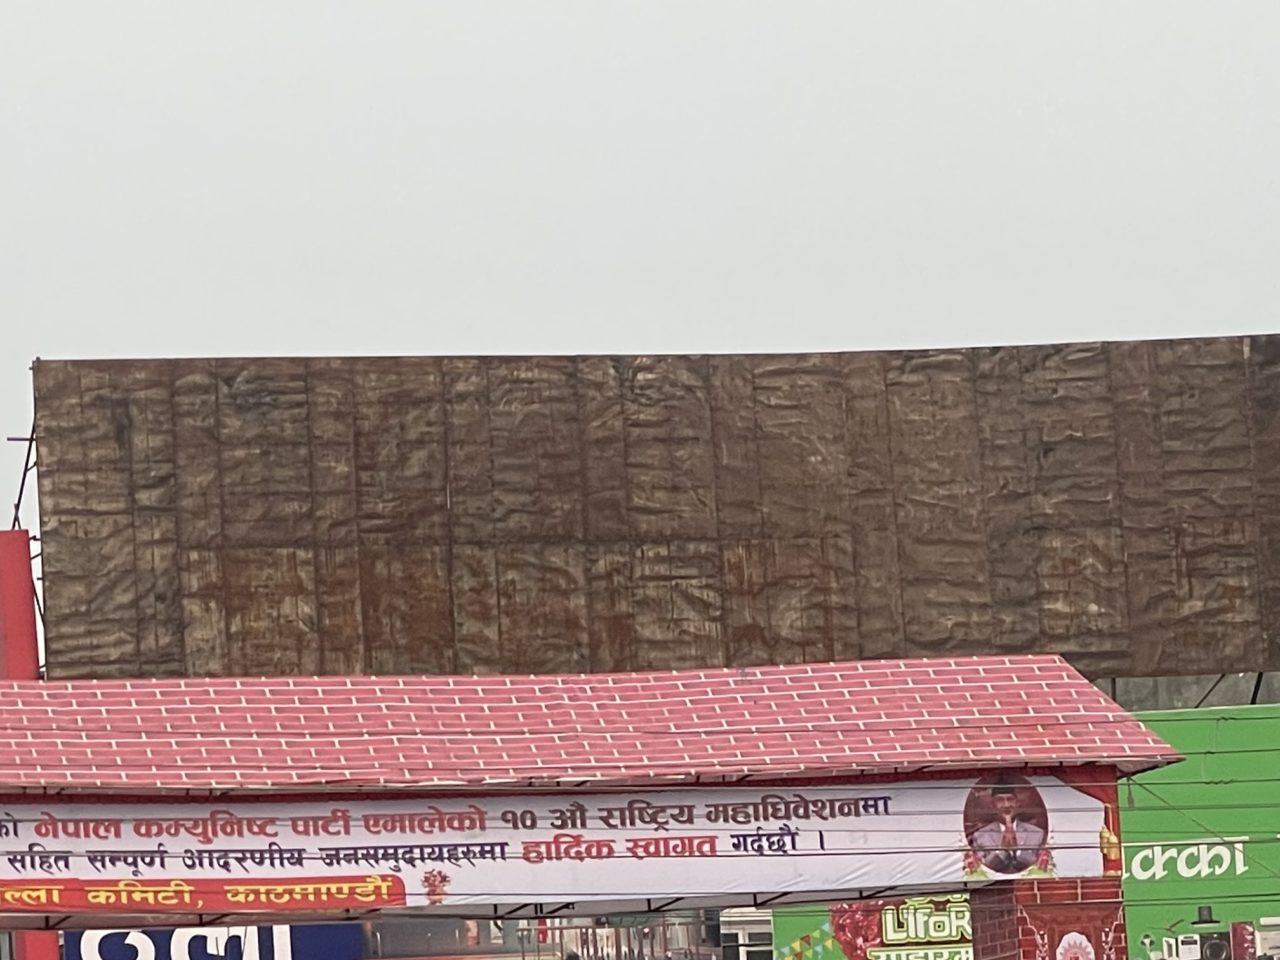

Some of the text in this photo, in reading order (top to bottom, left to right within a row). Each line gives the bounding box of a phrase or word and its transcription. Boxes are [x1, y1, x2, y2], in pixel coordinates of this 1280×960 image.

[34, 811, 123, 839] नेपाल
[290, 808, 352, 838] पार्टी
[362, 804, 488, 835] एमालेको
[500, 809, 538, 830] १०
[705, 794, 892, 825] महाधिवेशनमा
[7, 843, 72, 875] सहित
[85, 843, 169, 877] सम्पूर्ण
[521, 833, 616, 863] हार्दिक
[625, 834, 718, 861] स्वागत
